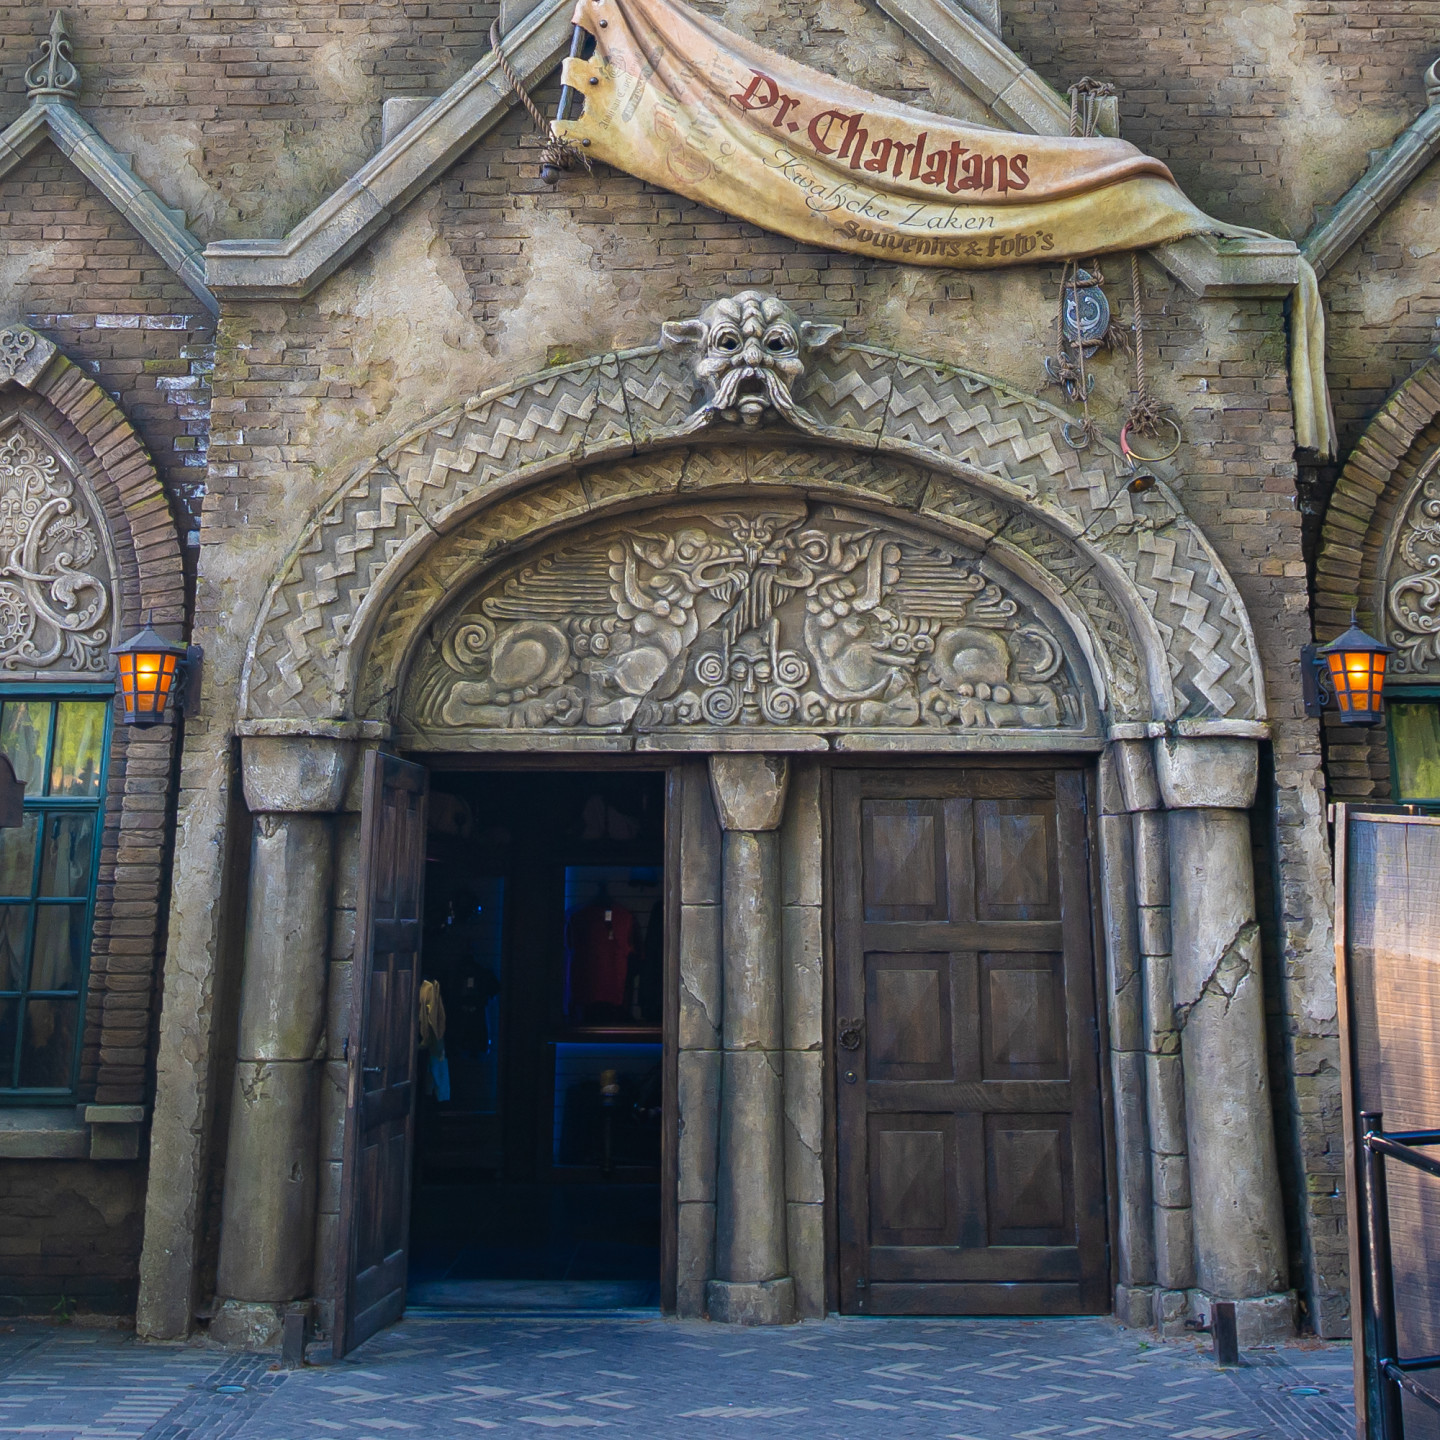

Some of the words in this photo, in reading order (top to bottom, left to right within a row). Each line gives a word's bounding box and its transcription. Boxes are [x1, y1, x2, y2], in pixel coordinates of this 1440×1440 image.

[728, 69, 800, 133] Dr.
[808, 108, 1031, 197] Charlatans
[762, 148, 890, 221] Kwalycke
[898, 203, 996, 230] Zaken
[833, 219, 961, 257] Souvenirs
[963, 239, 983, 257] &
[986, 230, 1056, 258] Foto's
